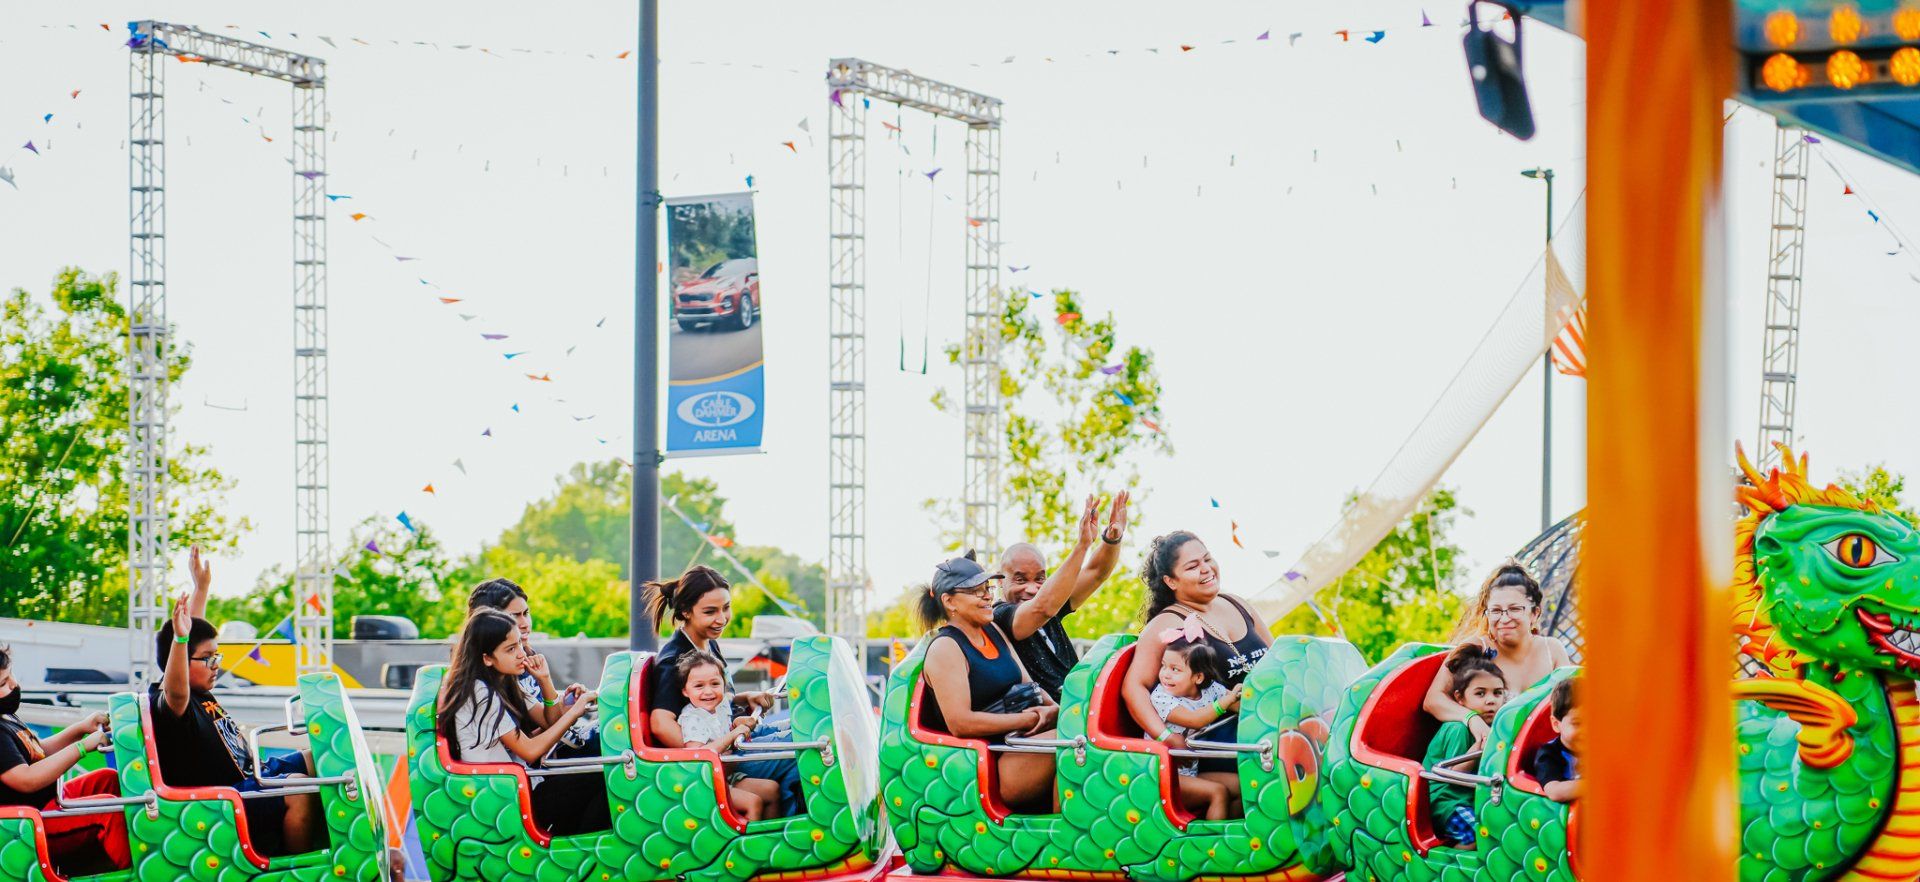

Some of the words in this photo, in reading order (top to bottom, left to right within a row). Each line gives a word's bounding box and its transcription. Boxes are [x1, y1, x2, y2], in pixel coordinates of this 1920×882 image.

[701, 398, 732, 409] CABLE
[695, 406, 737, 418] DAHMER
[693, 429, 737, 442] ARENA
[1227, 654, 1248, 668] Not
